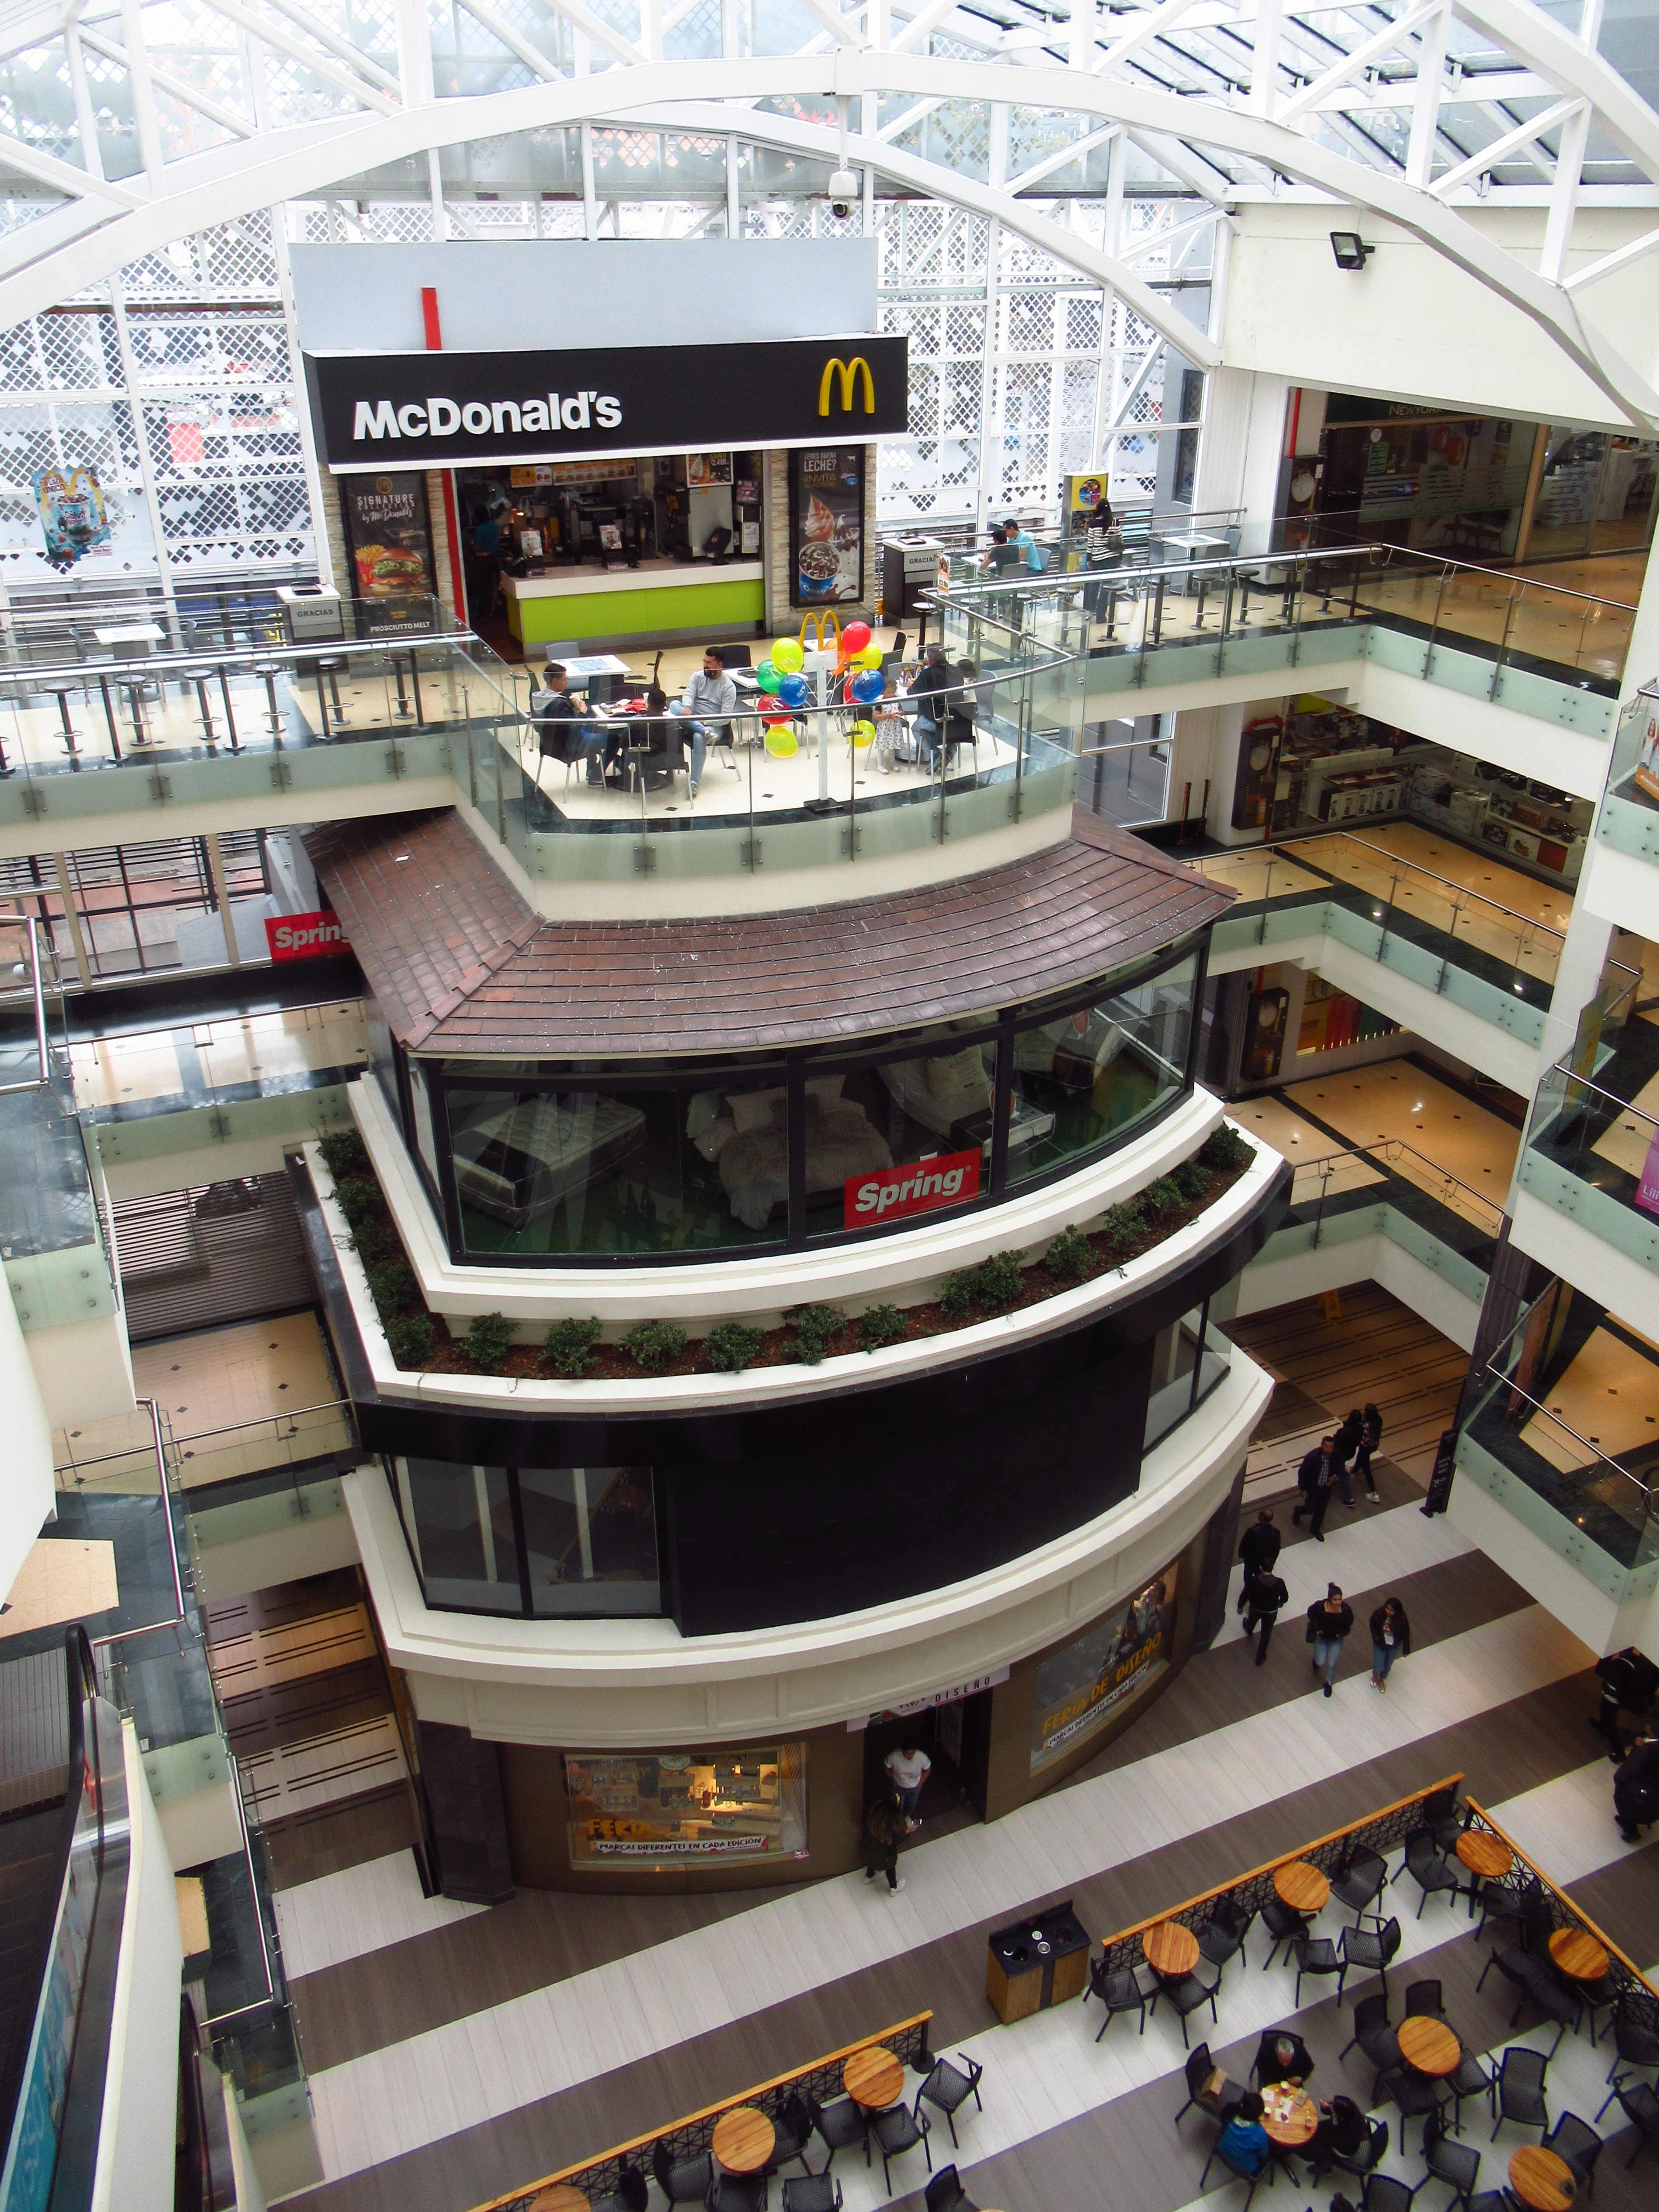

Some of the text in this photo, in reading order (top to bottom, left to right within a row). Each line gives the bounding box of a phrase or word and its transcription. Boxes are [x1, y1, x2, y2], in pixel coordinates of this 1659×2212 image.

[354, 391, 623, 440] McDonald's
[804, 459, 837, 472] LECHE?
[357, 494, 414, 506] SIGNATURE
[358, 502, 415, 510] COLLECTION
[362, 514, 370, 524] by
[298, 609, 333, 617] GRACIAS
[370, 623, 413, 633] PROSCIUTTO
[275, 921, 350, 951] Sprin
[855, 1168, 964, 1214] Spring
[935, 1677, 990, 1702] DISEÑO
[1091, 1676, 1109, 1702] DE
